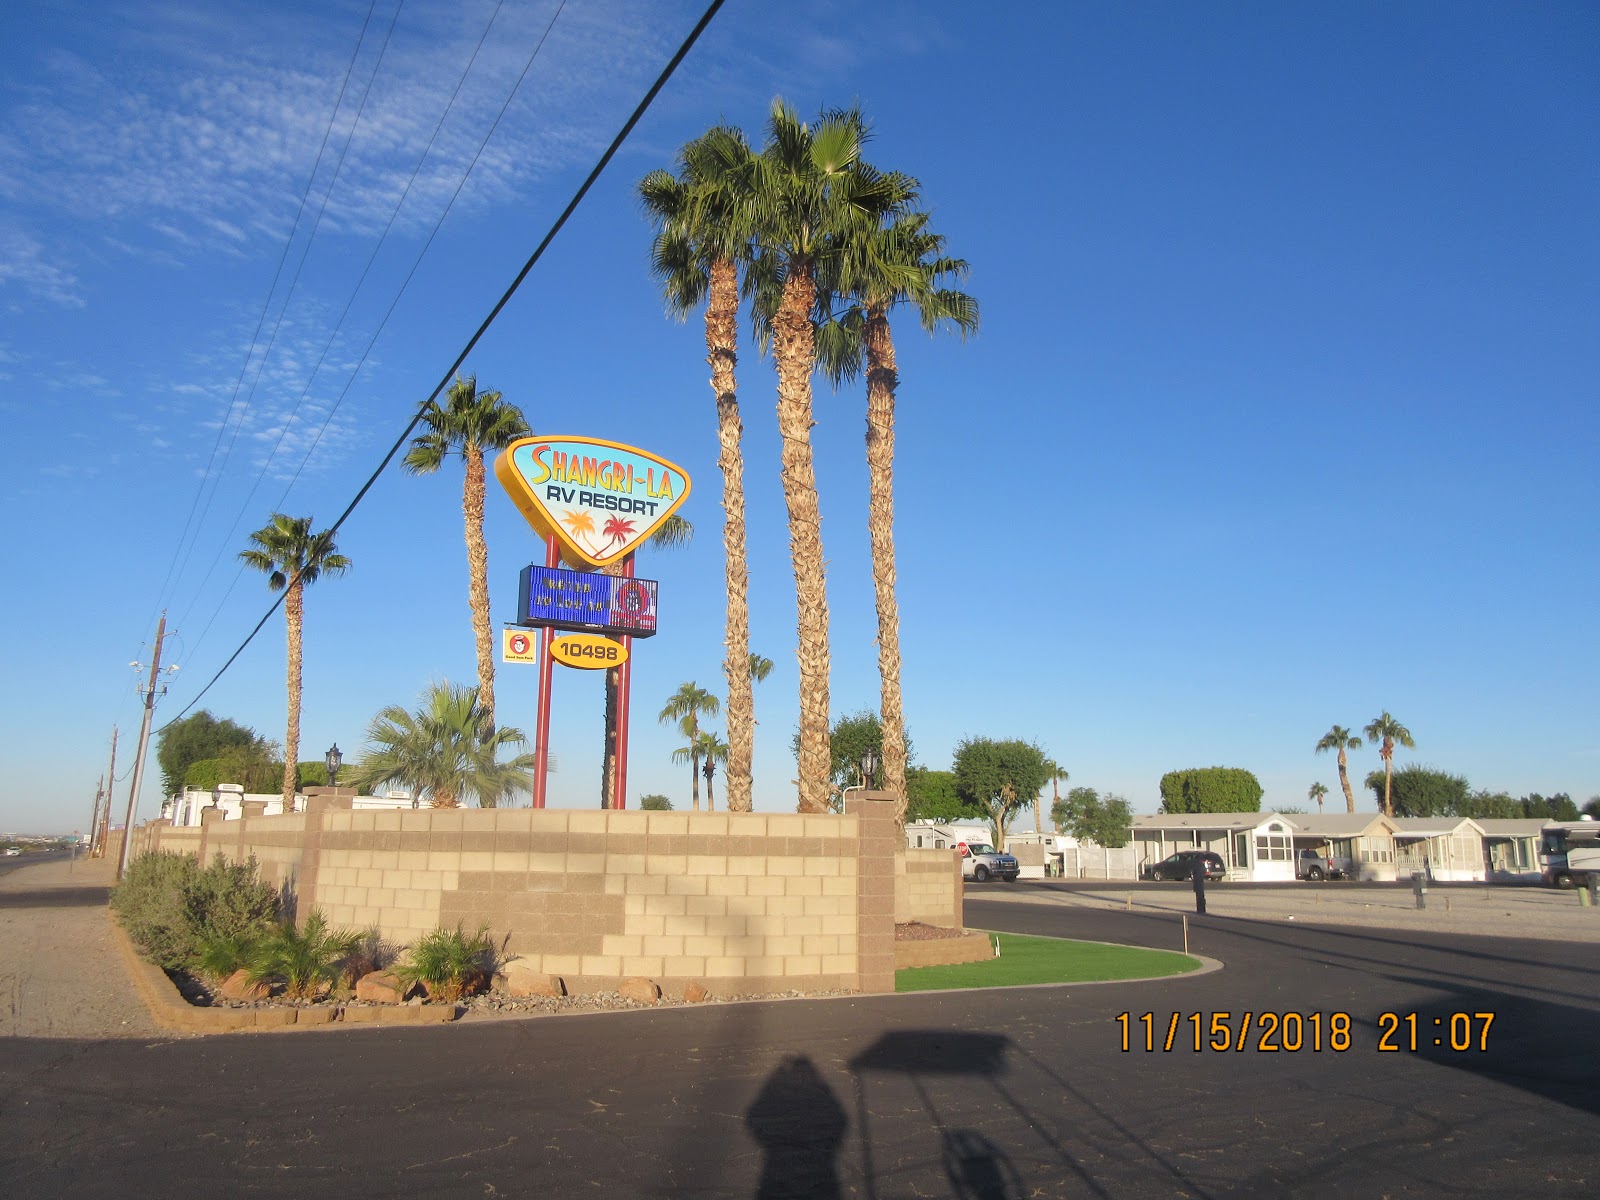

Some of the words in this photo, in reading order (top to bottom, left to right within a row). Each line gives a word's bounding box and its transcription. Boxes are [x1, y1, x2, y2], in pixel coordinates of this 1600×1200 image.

[531, 445, 674, 500] SHANGRI-LA
[546, 485, 576, 503] RV
[579, 490, 658, 516] RESORT
[560, 643, 617, 660] 10498
